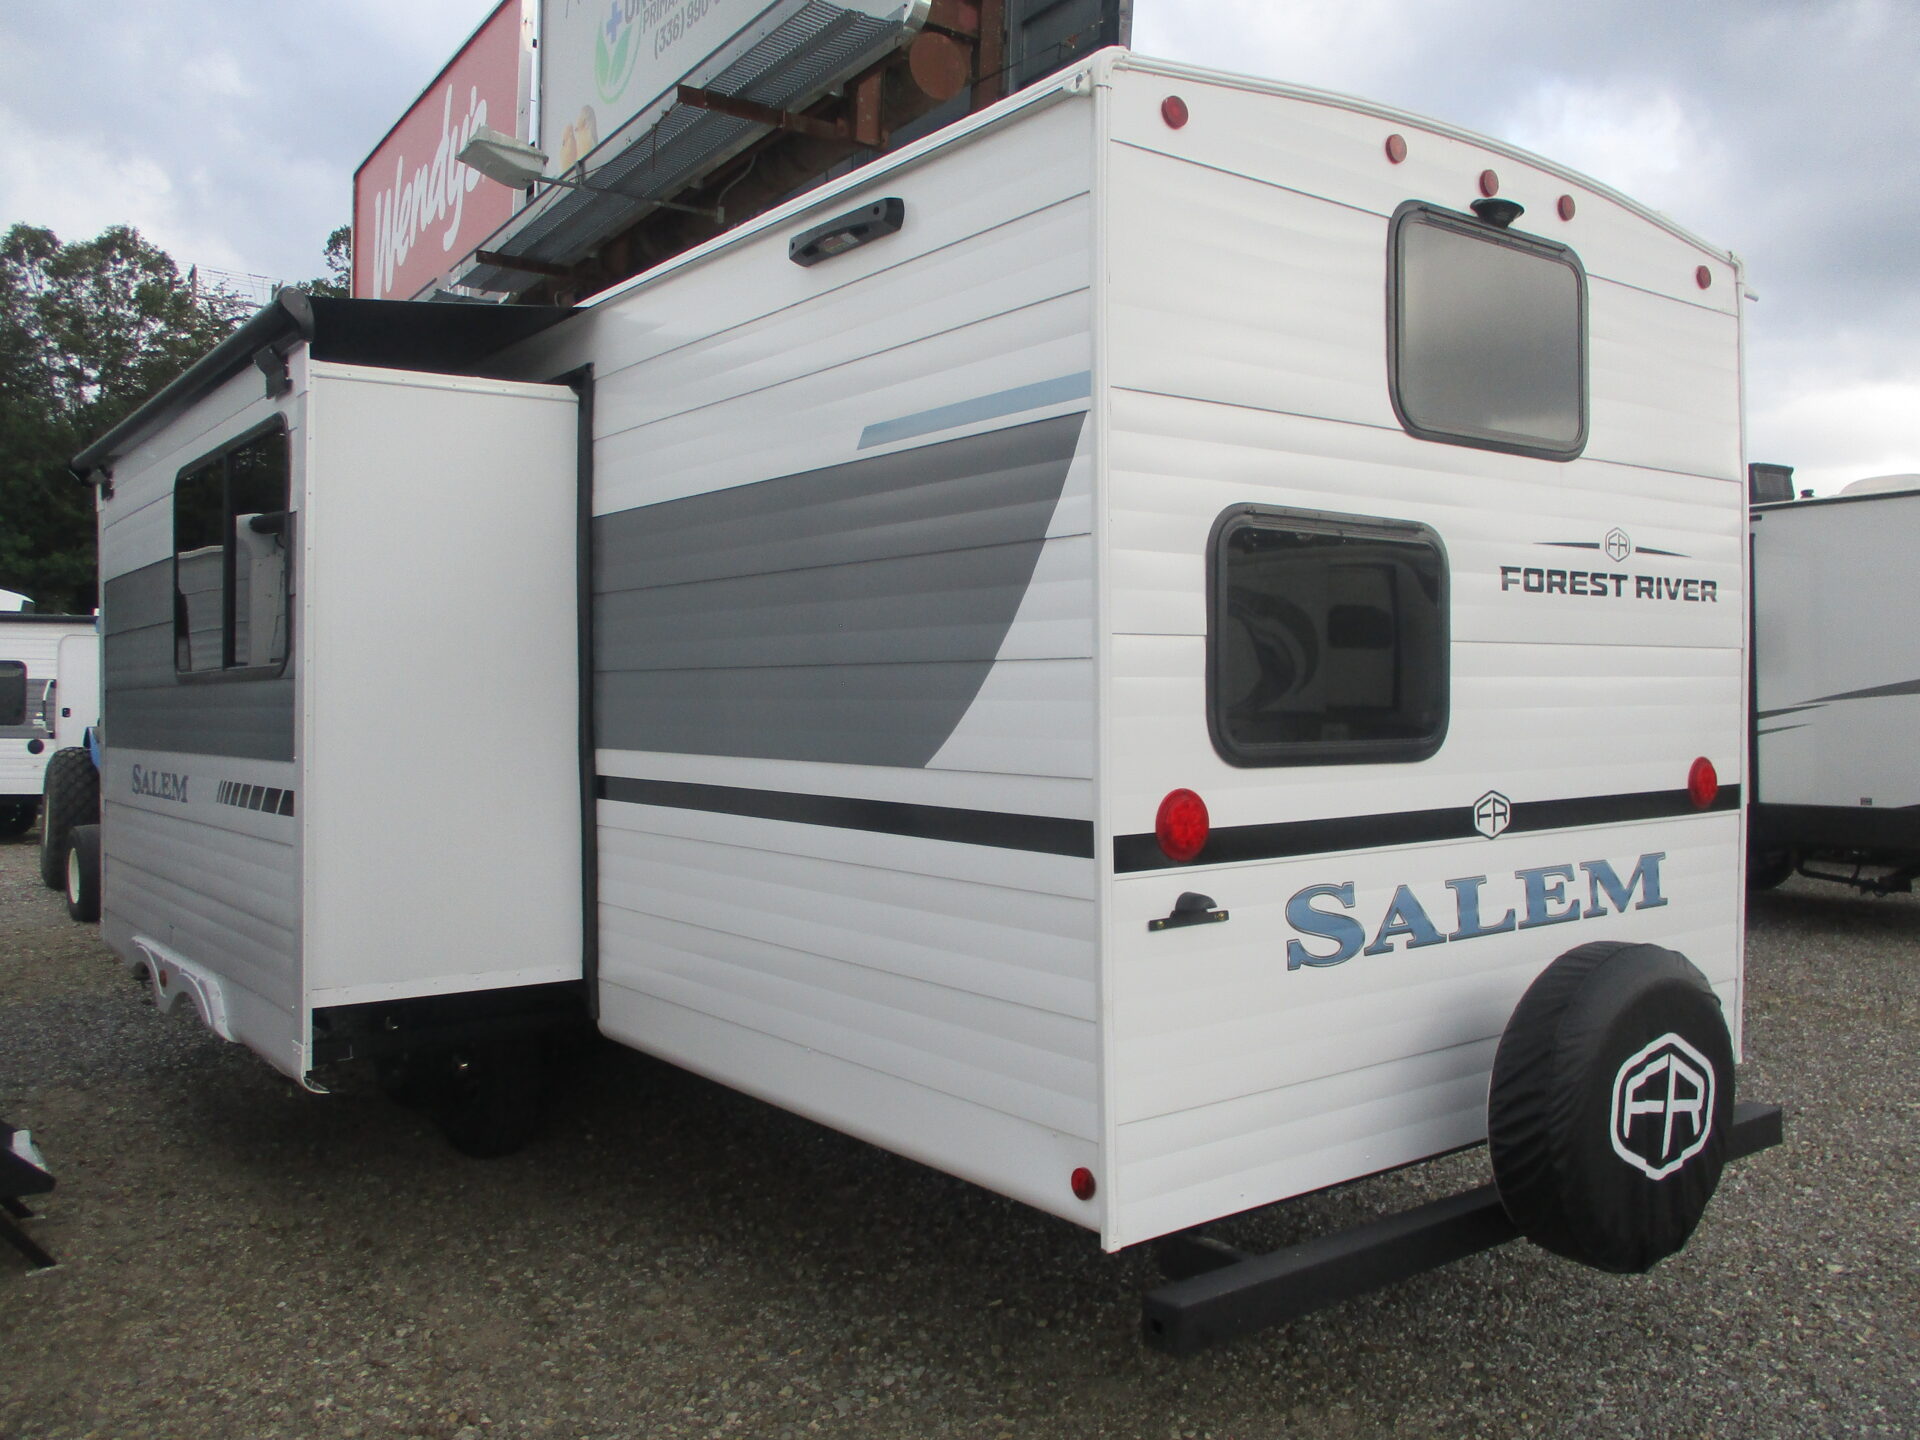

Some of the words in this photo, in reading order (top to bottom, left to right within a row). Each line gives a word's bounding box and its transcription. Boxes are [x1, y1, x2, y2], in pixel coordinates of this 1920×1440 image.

[1500, 565, 1628, 598] FOREST
[1635, 574, 1717, 602] RIVER
[132, 764, 189, 804] SALEM
[1285, 852, 1668, 971] SALEM
